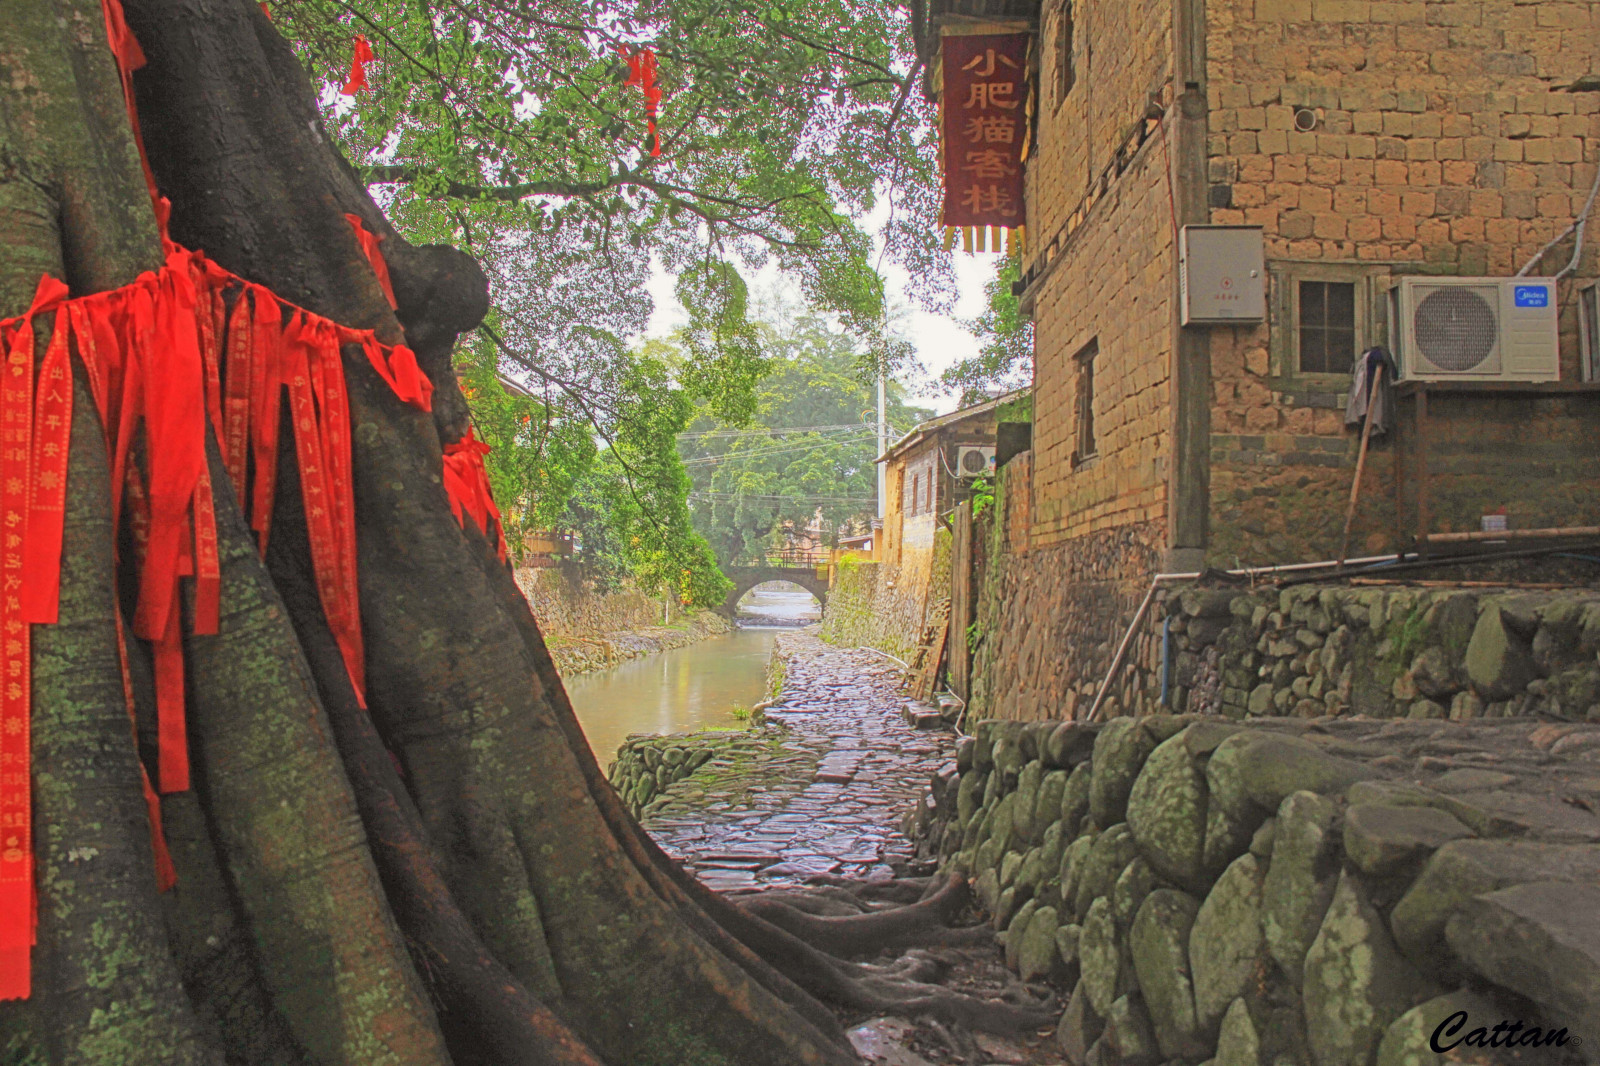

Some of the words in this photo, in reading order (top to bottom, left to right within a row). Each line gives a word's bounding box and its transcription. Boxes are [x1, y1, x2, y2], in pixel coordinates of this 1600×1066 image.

[961, 48, 1019, 217] 小肥猫客栈
[43, 366, 64, 457] 出入平安
